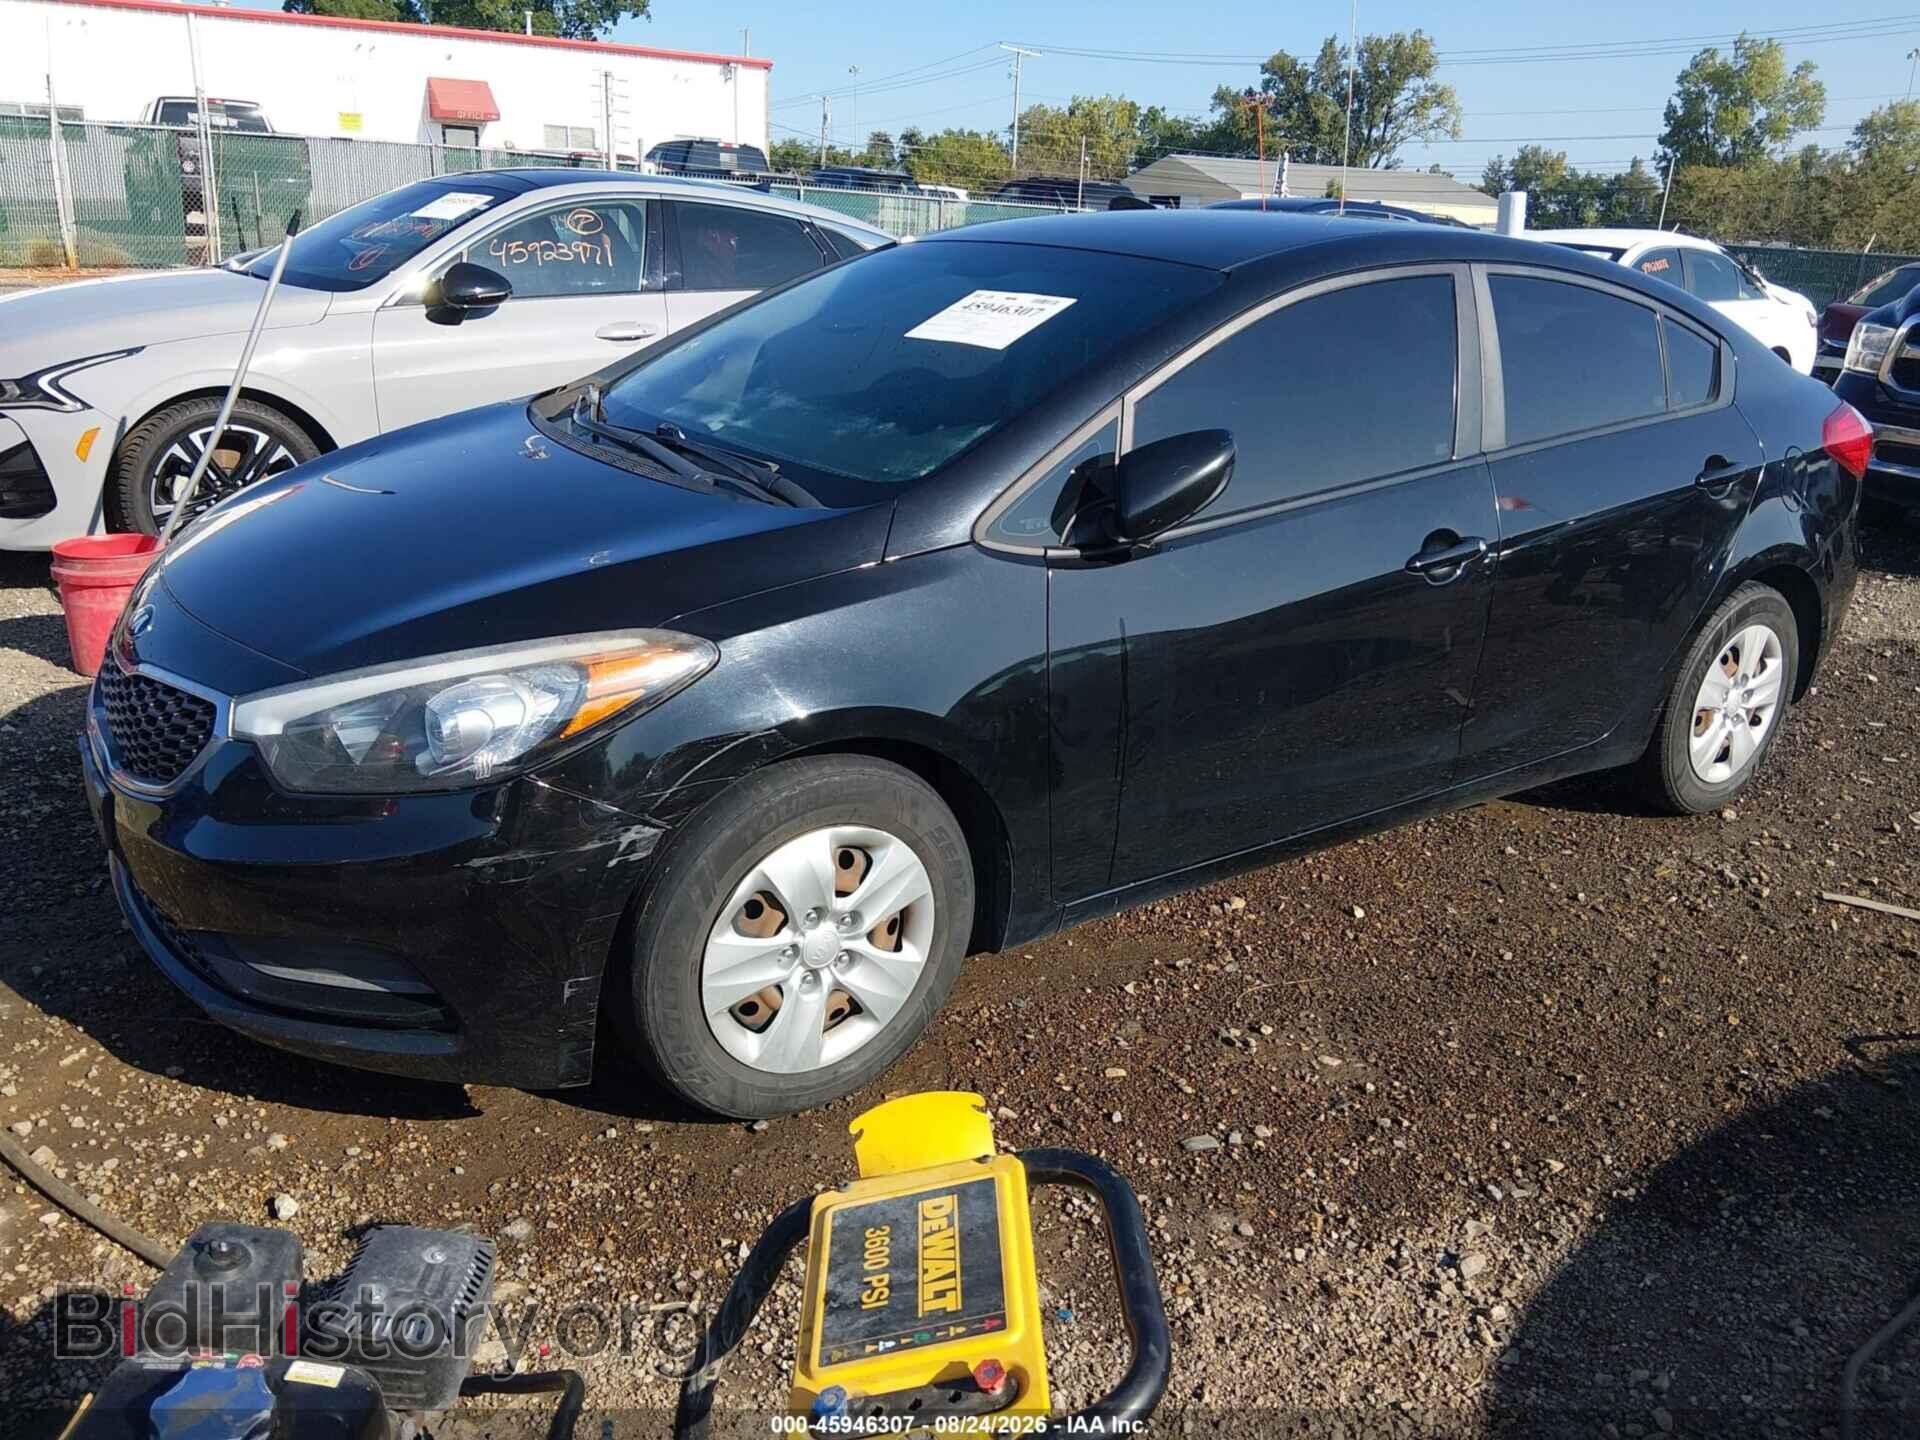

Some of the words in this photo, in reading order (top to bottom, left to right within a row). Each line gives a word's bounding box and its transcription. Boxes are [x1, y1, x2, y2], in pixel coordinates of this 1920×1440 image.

[489, 235, 613, 267] 45923971
[962, 301, 1046, 318] 45946307
[864, 1224, 891, 1271] 3600
[861, 1272, 890, 1310] PSI
